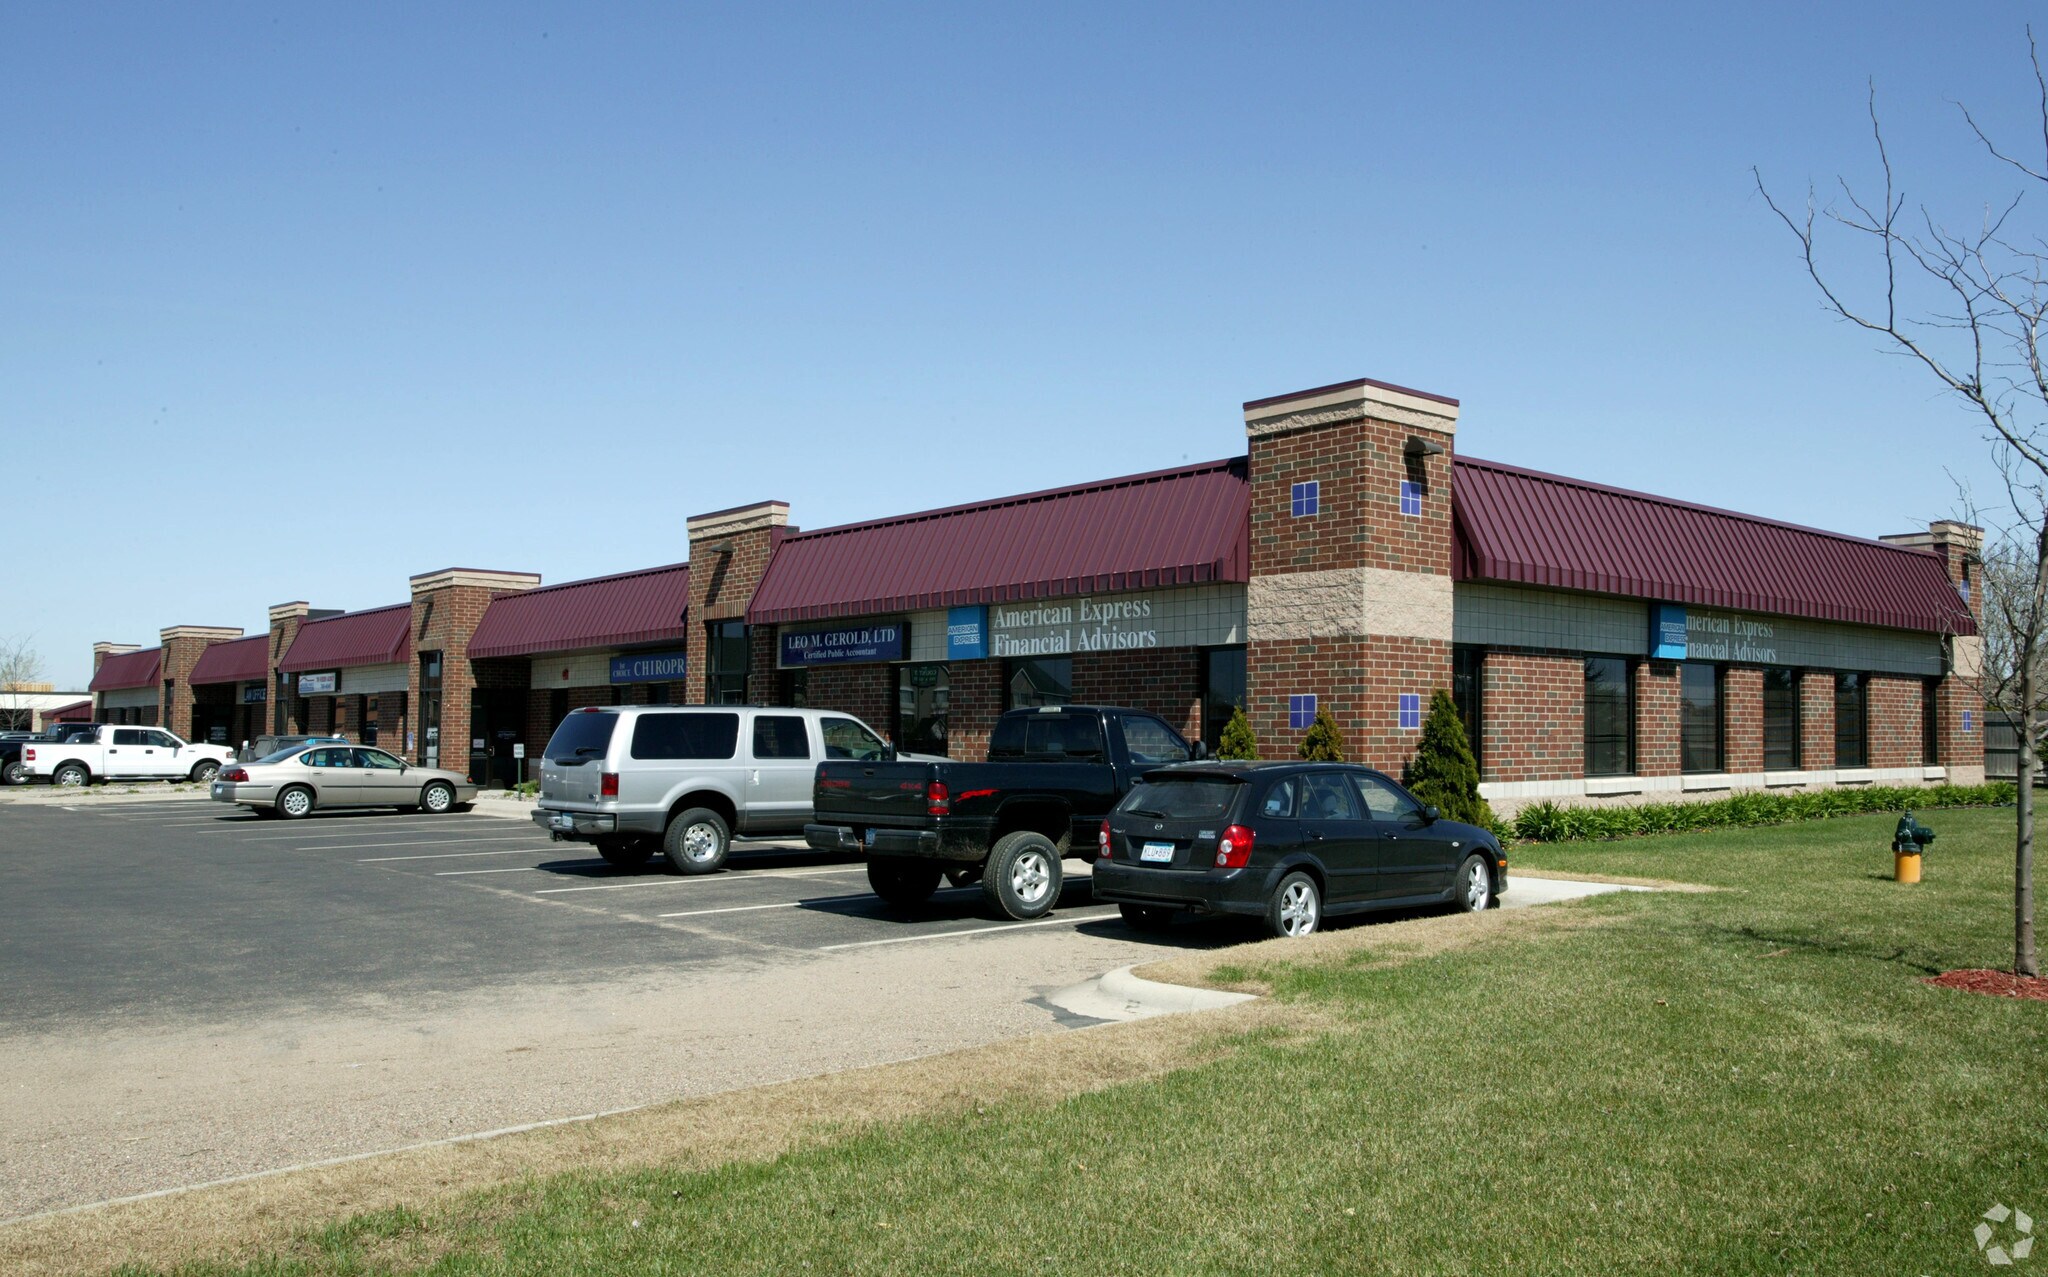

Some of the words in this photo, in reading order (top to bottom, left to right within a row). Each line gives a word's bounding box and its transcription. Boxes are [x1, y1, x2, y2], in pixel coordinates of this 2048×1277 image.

[994, 602, 1072, 629] American
[1079, 597, 1151, 626] Express
[948, 624, 979, 634] AMERICAN
[1686, 611, 1730, 634] merican
[1734, 615, 1774, 641] Express
[788, 635, 808, 649] LEO
[811, 634, 823, 648] M.
[824, 630, 872, 647] GEROLD,
[874, 628, 896, 643] LTD
[954, 634, 981, 645] EXPRESS
[994, 629, 1073, 656] Financial
[1077, 626, 1157, 651] Advisors
[803, 650, 827, 660] Certified
[827, 648, 844, 658] Public
[845, 647, 877, 657] Accountant
[1685, 639, 1729, 659] inancial
[1732, 641, 1776, 662] Advisors
[633, 658, 685, 677] CHIROPR
